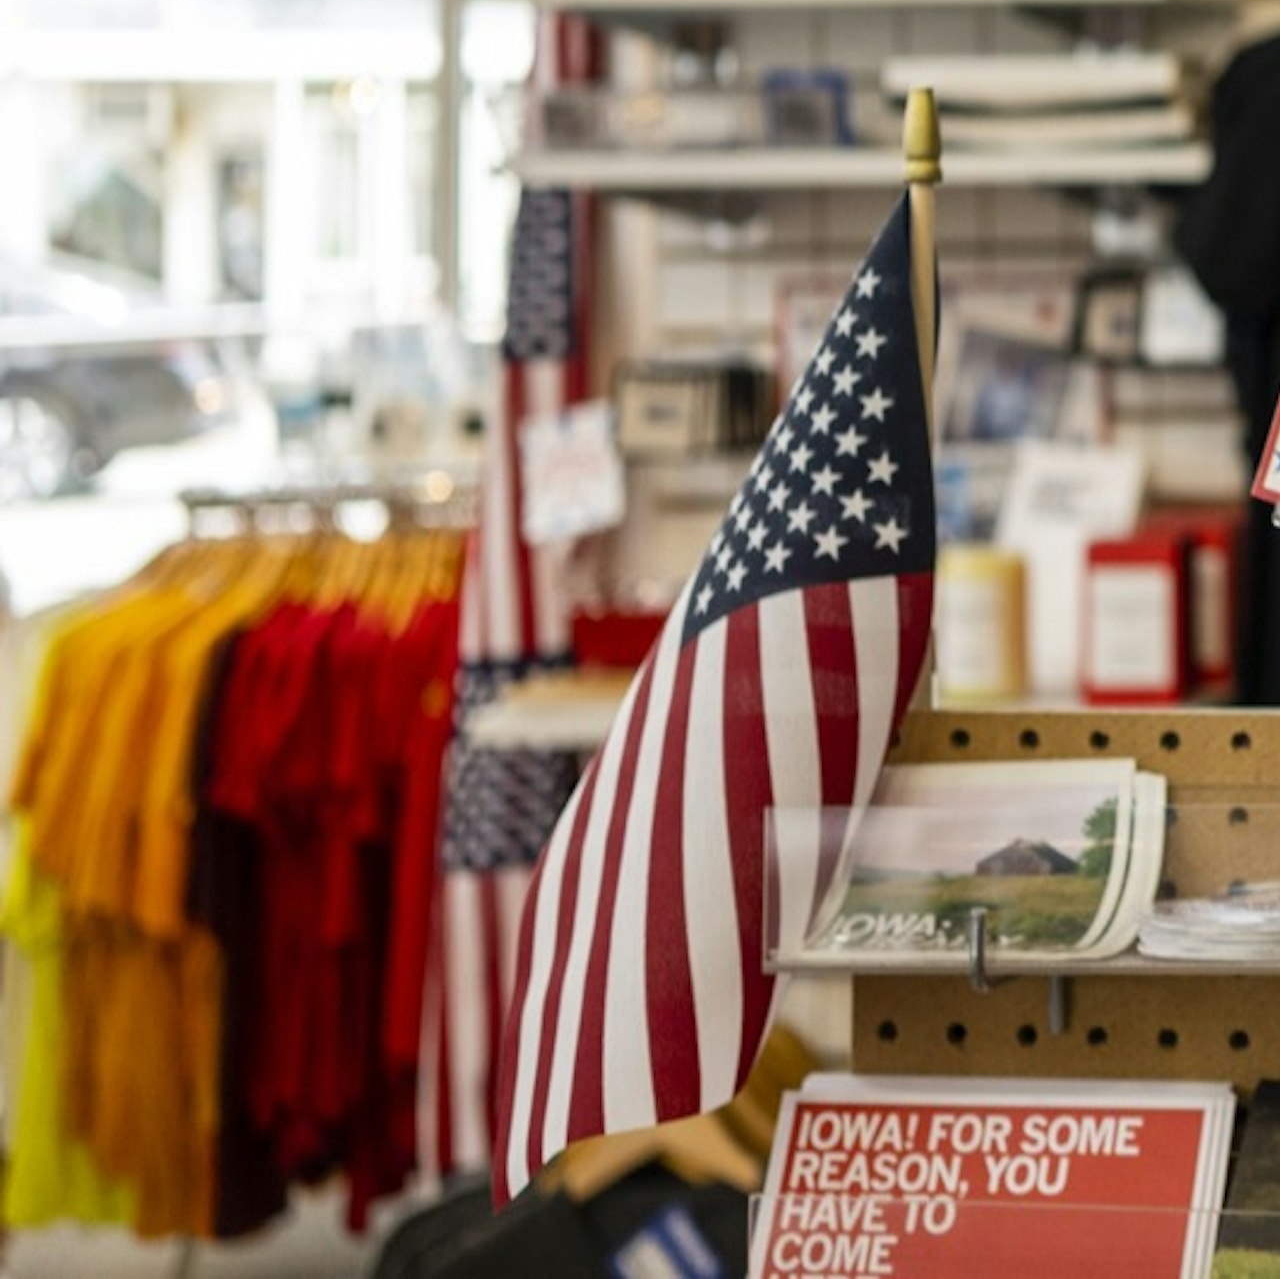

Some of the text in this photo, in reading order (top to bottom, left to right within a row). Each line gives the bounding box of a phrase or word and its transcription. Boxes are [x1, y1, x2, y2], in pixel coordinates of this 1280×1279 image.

[797, 1111, 1143, 1156] IOWA! FOR SOME
[789, 1153, 1070, 1197] REASON, YOU
[779, 1193, 957, 1234] HAVE TO
[771, 1233, 898, 1274] COME
